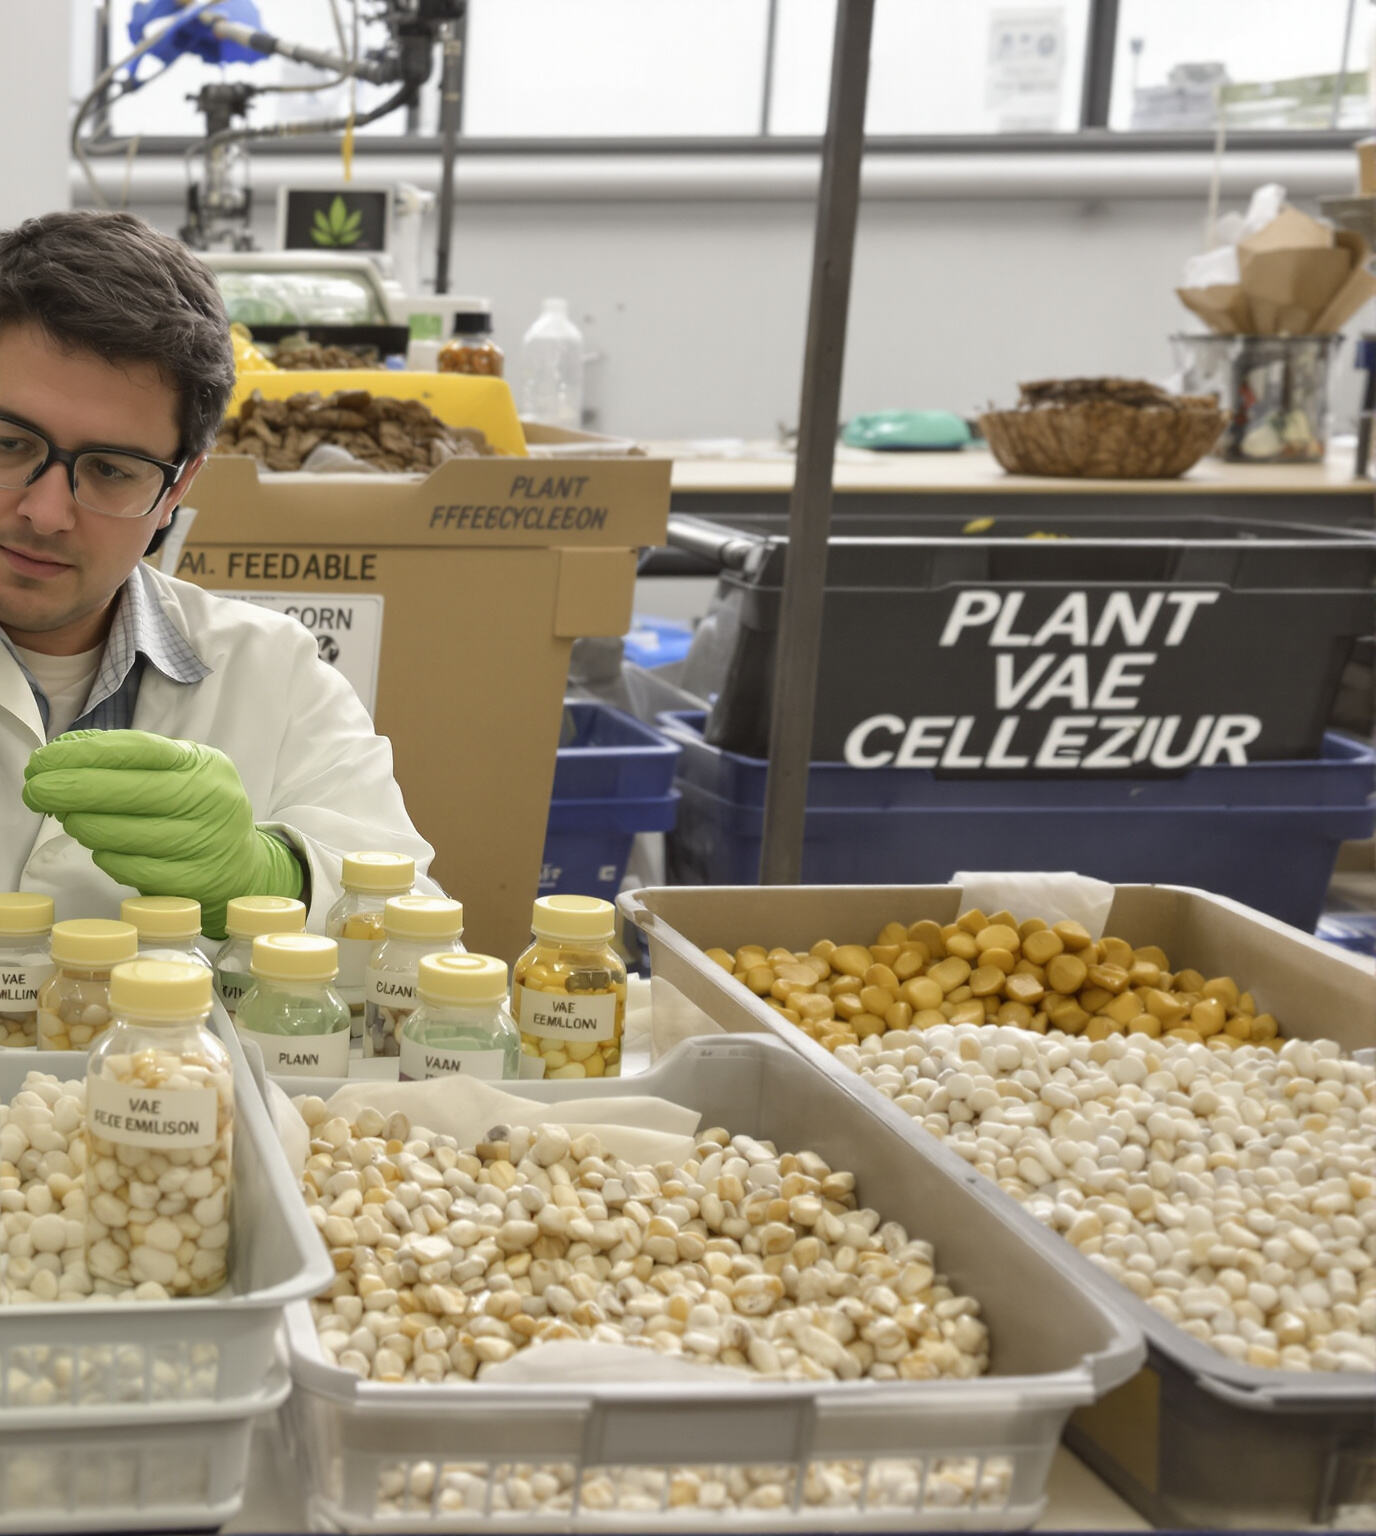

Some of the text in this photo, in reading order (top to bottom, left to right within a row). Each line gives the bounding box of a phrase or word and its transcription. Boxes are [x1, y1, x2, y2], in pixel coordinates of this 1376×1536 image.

[510, 476, 589, 499] PLANT
[227, 553, 377, 581] FEEDABLE
[939, 591, 1220, 646] PLANT
[995, 653, 1158, 710] VAE
[2, 973, 26, 985] VAE
[128, 1098, 161, 1115] VAE
